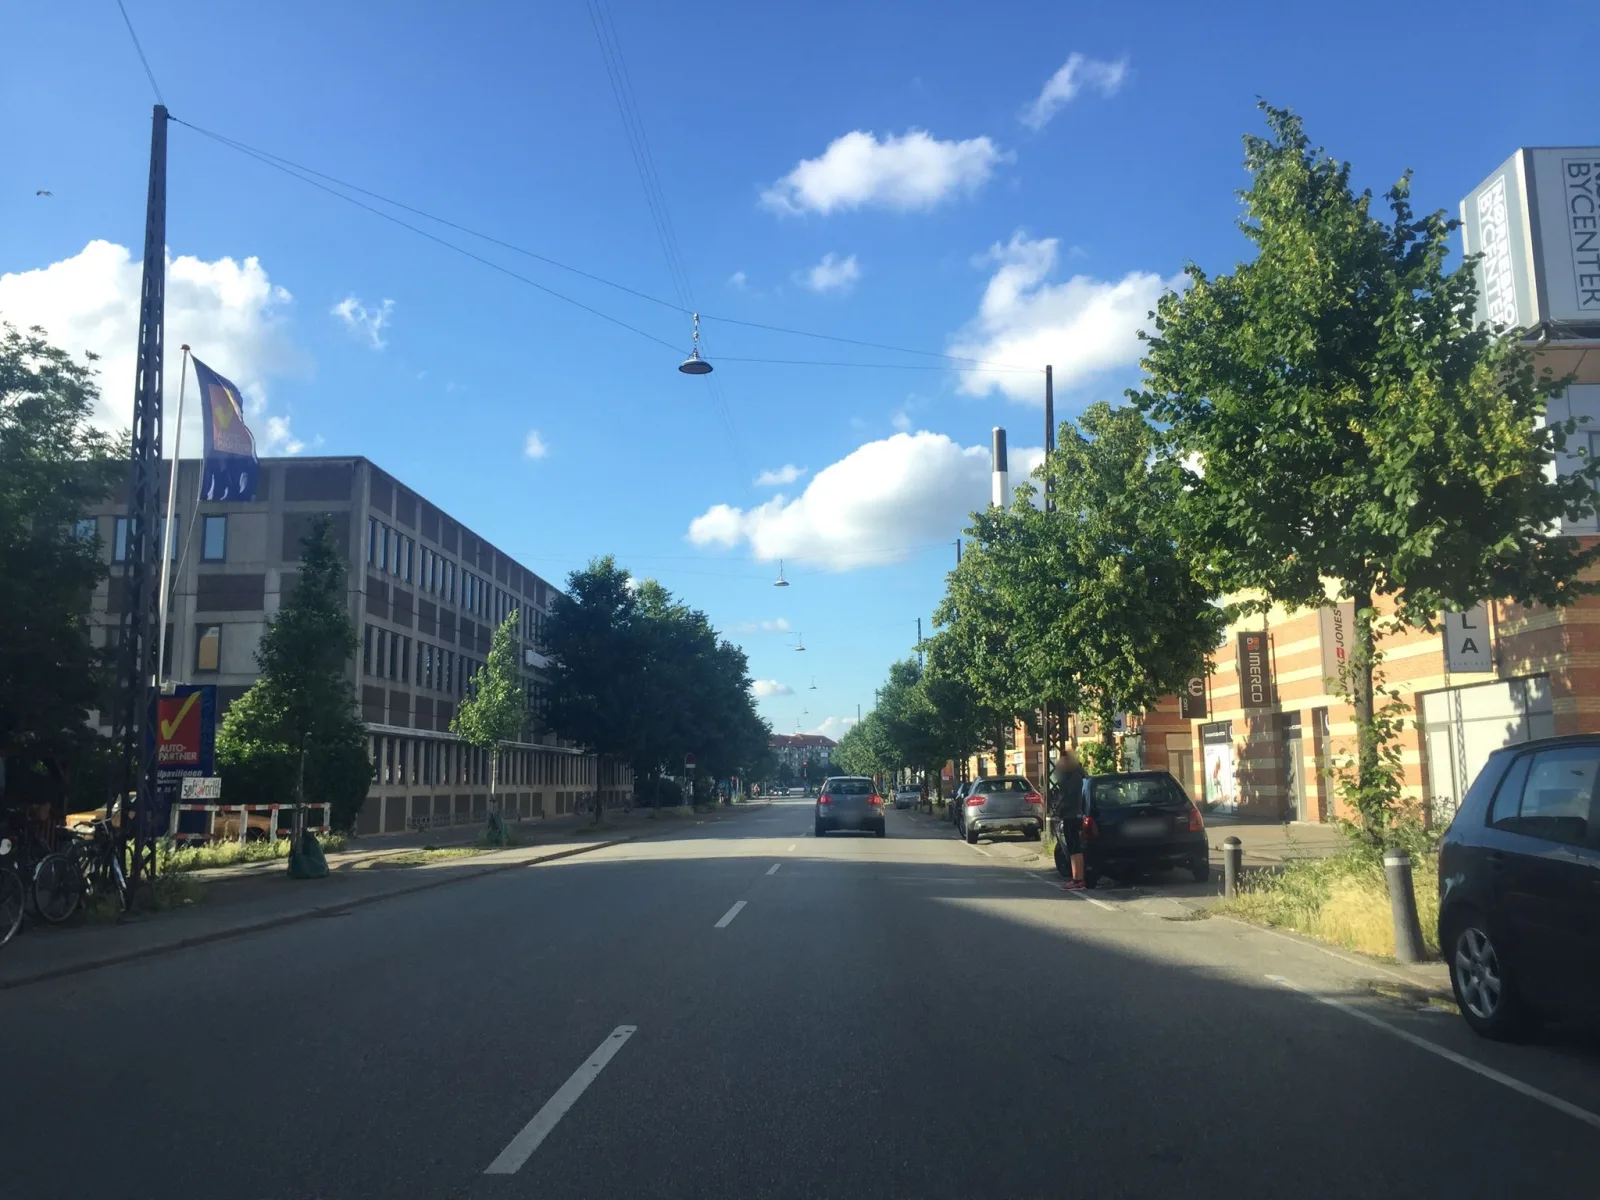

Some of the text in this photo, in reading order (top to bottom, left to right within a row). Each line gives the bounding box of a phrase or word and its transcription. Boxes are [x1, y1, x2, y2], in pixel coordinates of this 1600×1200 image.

[1567, 162, 1600, 306] BYCENTER
[1333, 608, 1345, 648] JONES
[1248, 652, 1263, 703] IMERCO
[158, 751, 198, 761] PARTNER
